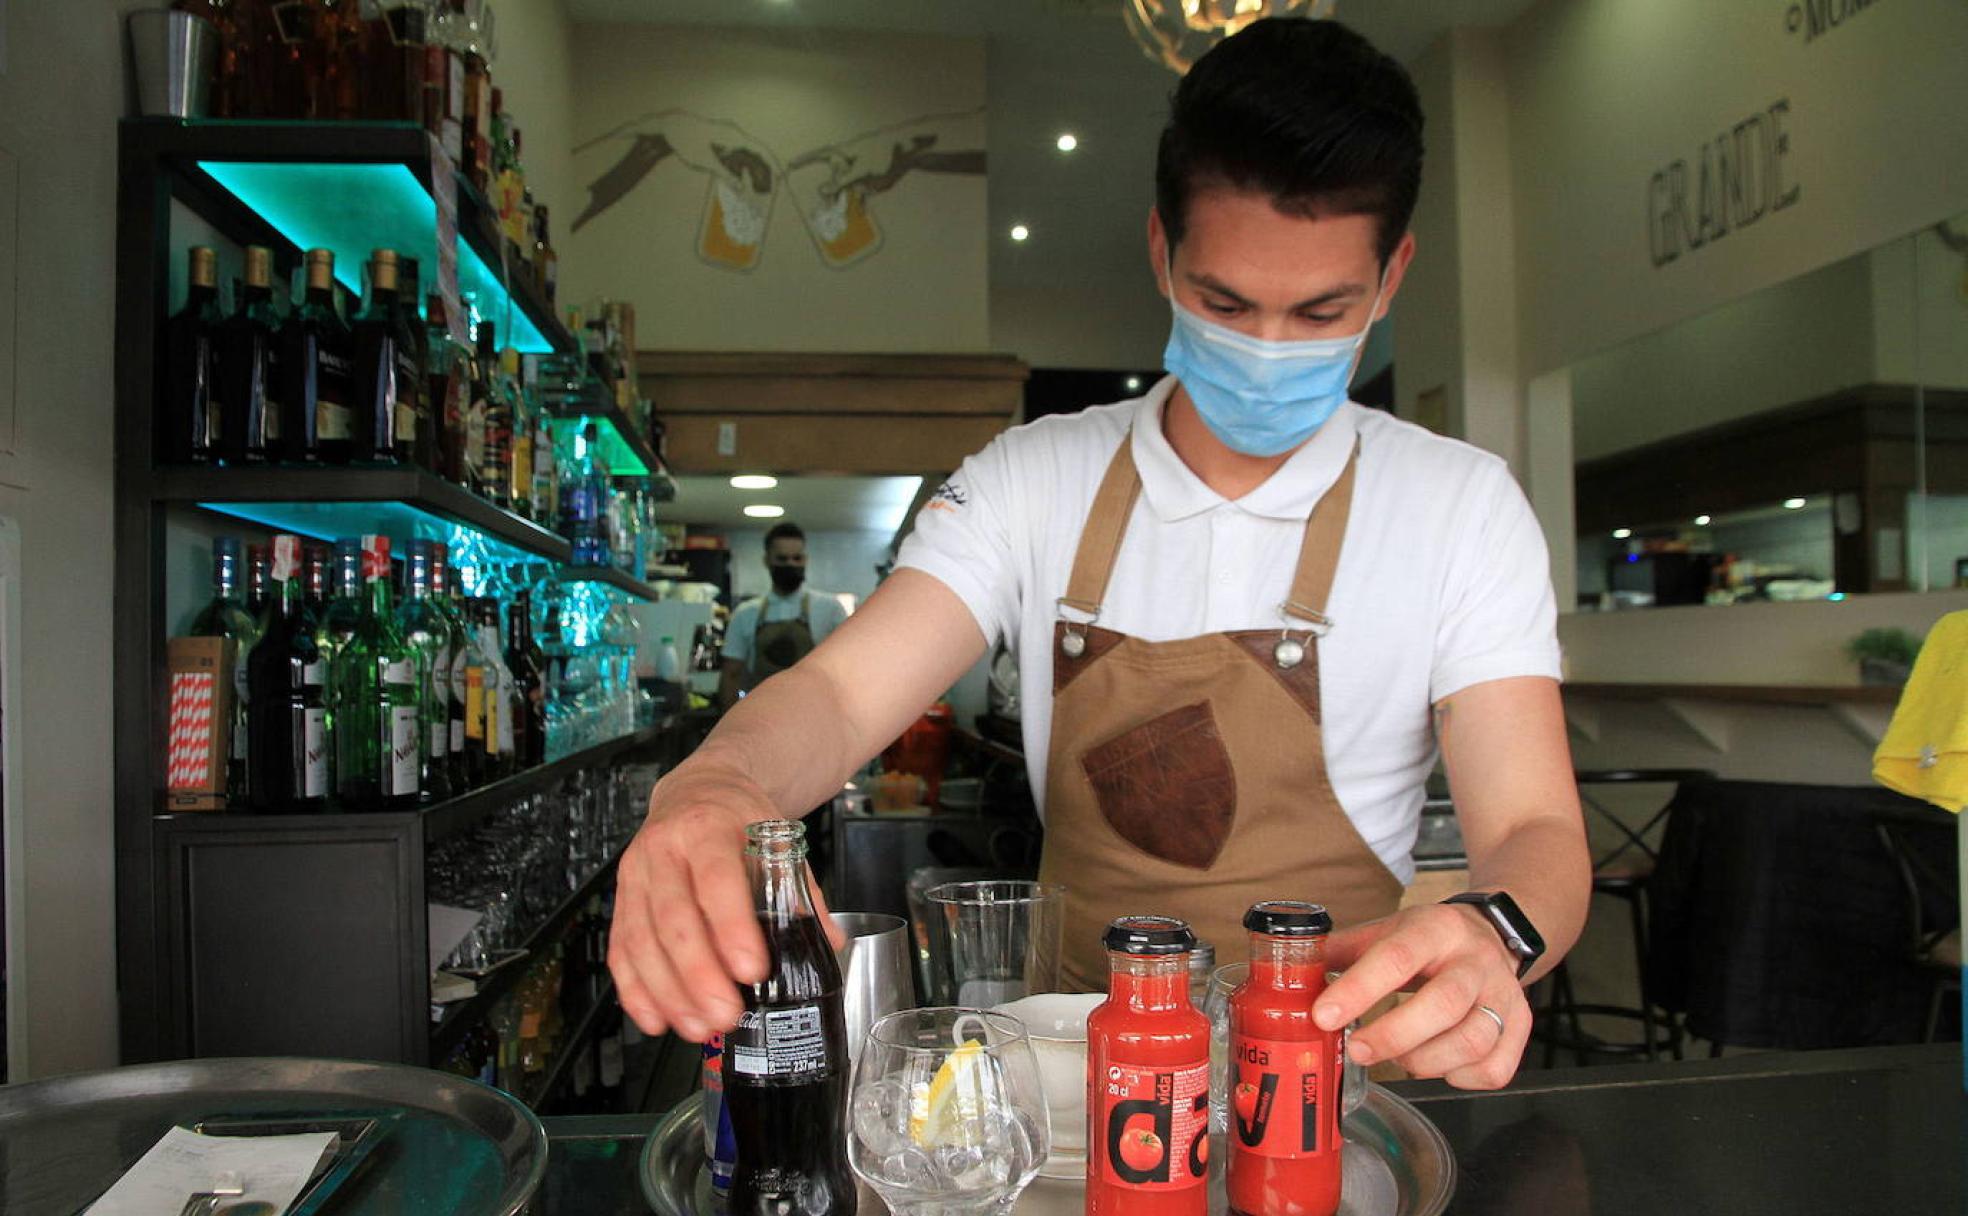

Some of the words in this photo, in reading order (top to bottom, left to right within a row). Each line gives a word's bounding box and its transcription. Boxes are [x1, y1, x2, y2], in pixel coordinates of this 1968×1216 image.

[1648, 97, 1800, 268] GRANDE
[1236, 1042, 1270, 1066] vida
[1157, 1075, 1172, 1106] vida
